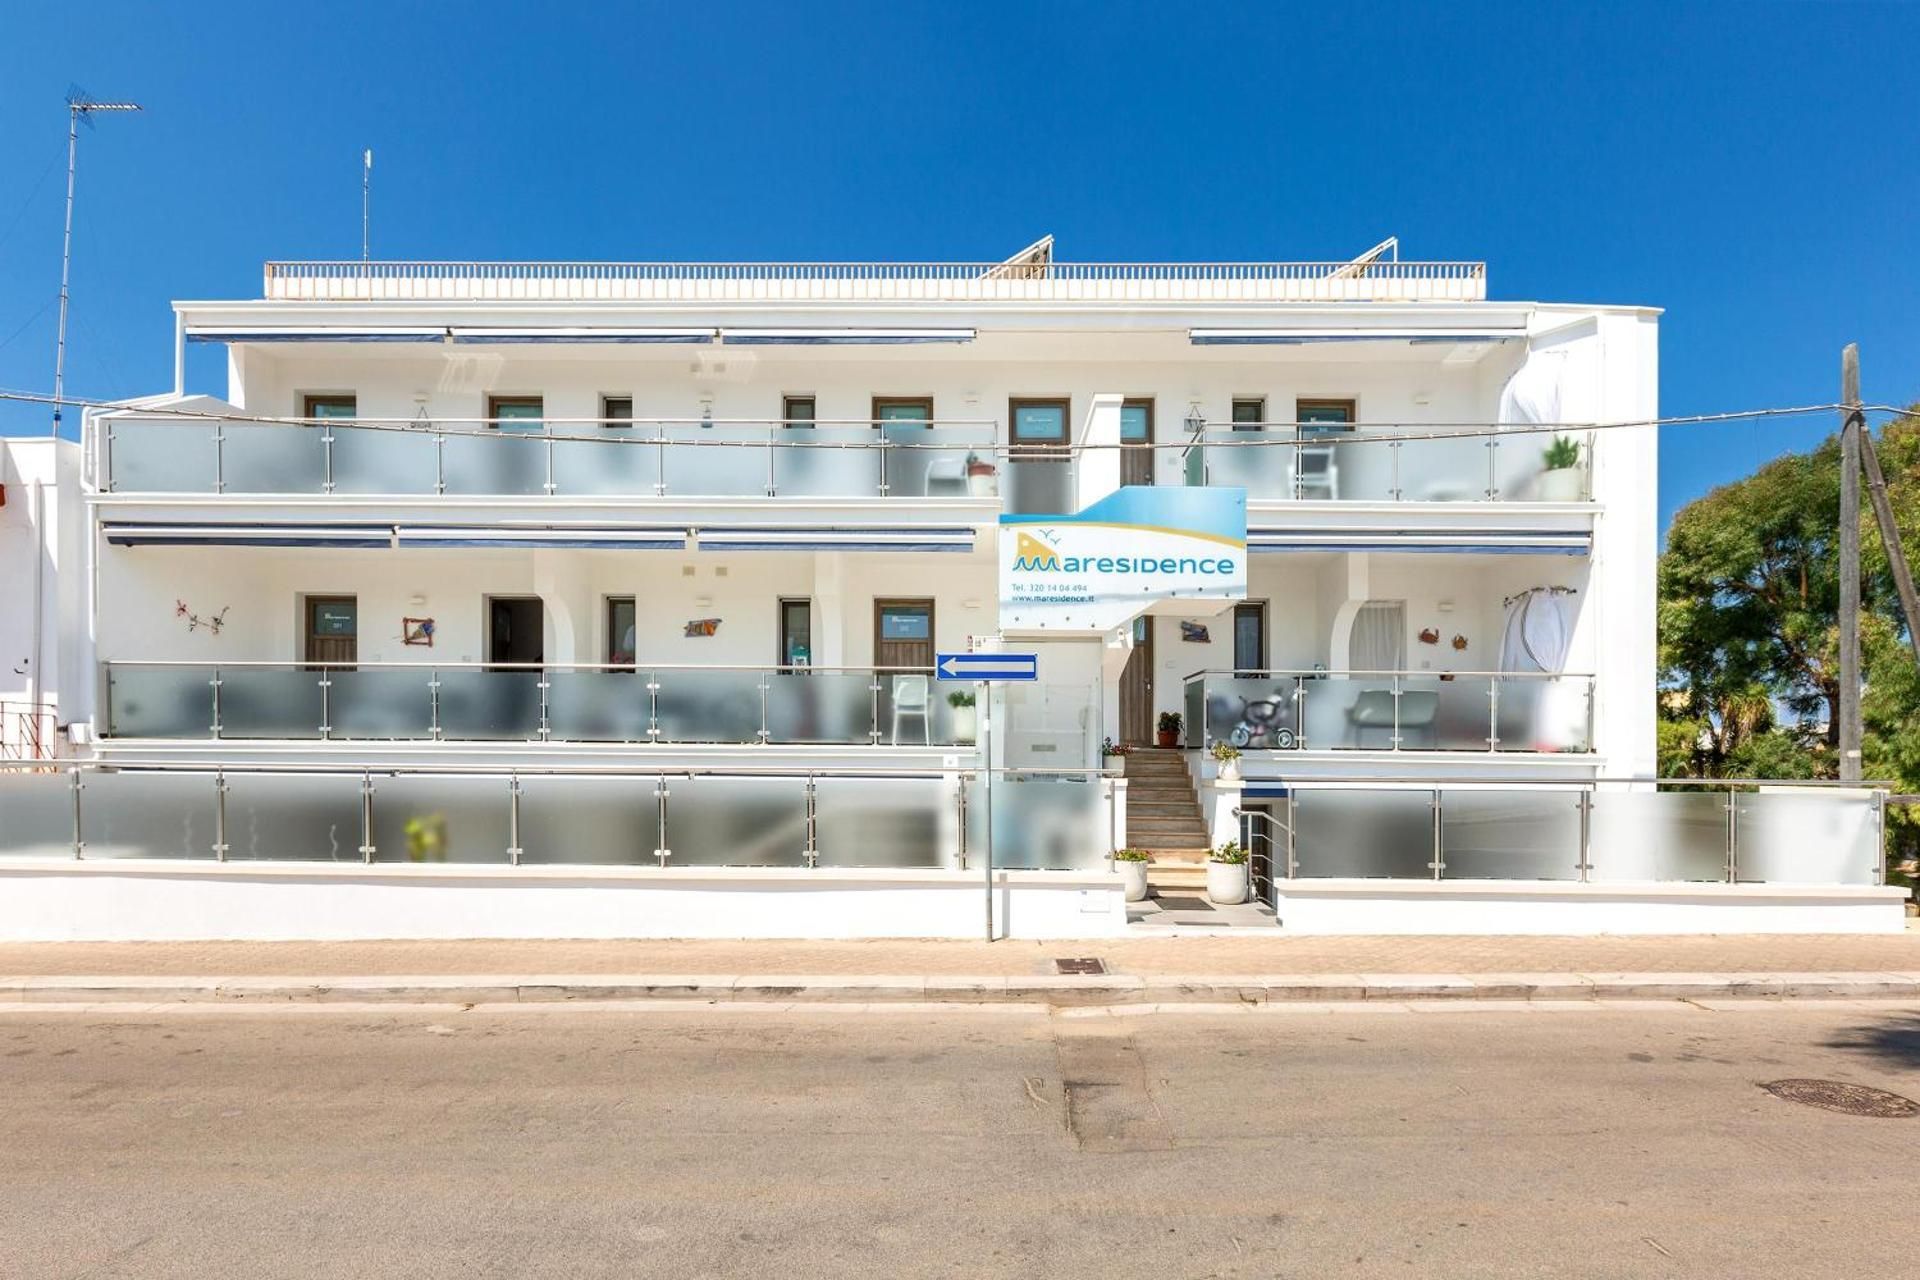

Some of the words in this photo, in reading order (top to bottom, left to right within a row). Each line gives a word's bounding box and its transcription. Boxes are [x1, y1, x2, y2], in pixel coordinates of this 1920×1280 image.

[1030, 583, 1044, 592] 320
[1047, 583, 1057, 592] 14
[1012, 594, 1095, 603] www.maresidence.it
